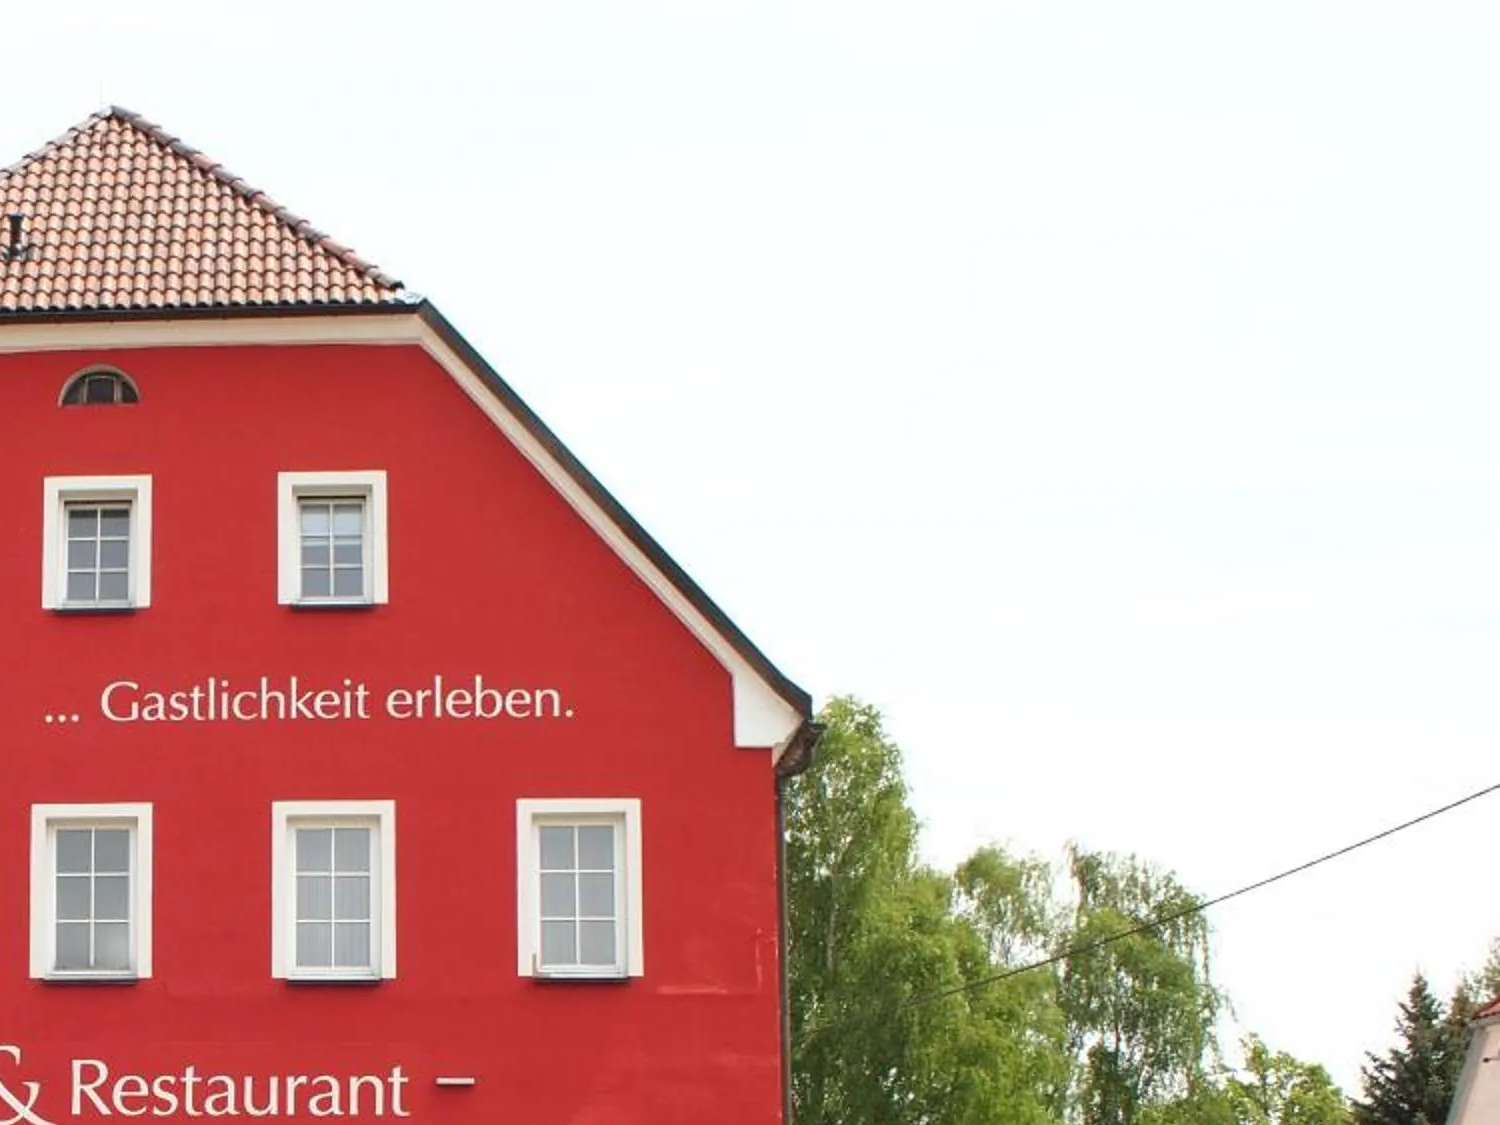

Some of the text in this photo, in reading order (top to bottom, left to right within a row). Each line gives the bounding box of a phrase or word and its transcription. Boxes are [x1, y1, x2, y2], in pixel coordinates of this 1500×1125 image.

[100, 676, 370, 722] Gastlichkeit
[386, 674, 574, 718] erleben.
[71, 1059, 410, 1118] Restaurant
